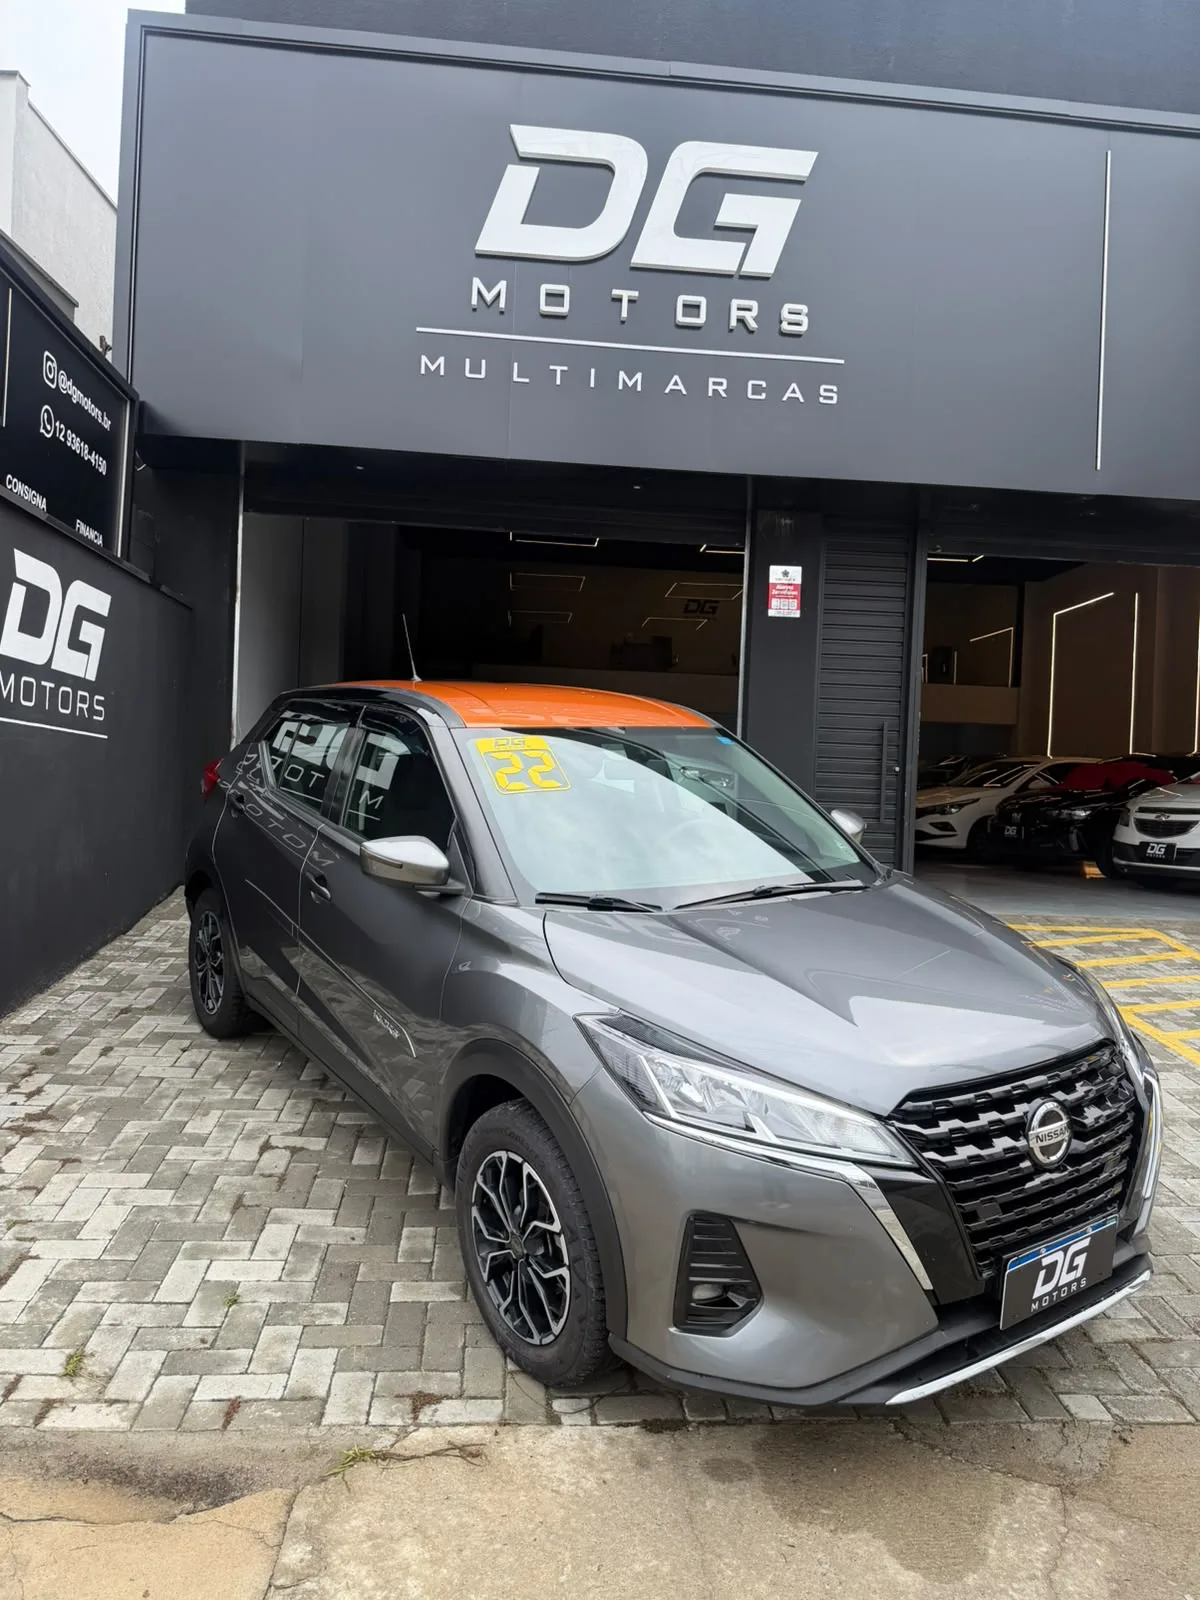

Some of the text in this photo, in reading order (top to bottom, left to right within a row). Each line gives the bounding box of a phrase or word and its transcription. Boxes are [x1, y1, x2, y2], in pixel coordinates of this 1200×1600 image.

[475, 124, 818, 279] DG
[470, 276, 809, 336] MOTORS
[58, 370, 111, 431] @dgmotors.br
[419, 354, 839, 405] MULTIMARCAS
[55, 420, 107, 476] 12 93618-4150
[6, 474, 47, 513] CONSIGNA
[76, 519, 104, 547] FINANCIA
[0, 548, 112, 682] DG
[682, 599, 720, 615] DG
[0, 670, 105, 721] MOTORS
[490, 749, 562, 791] 22
[1147, 843, 1167, 855] DG
[1035, 1124, 1069, 1143] NISSAN
[1032, 1236, 1091, 1300] DG
[1031, 1277, 1087, 1313] MOTORS
